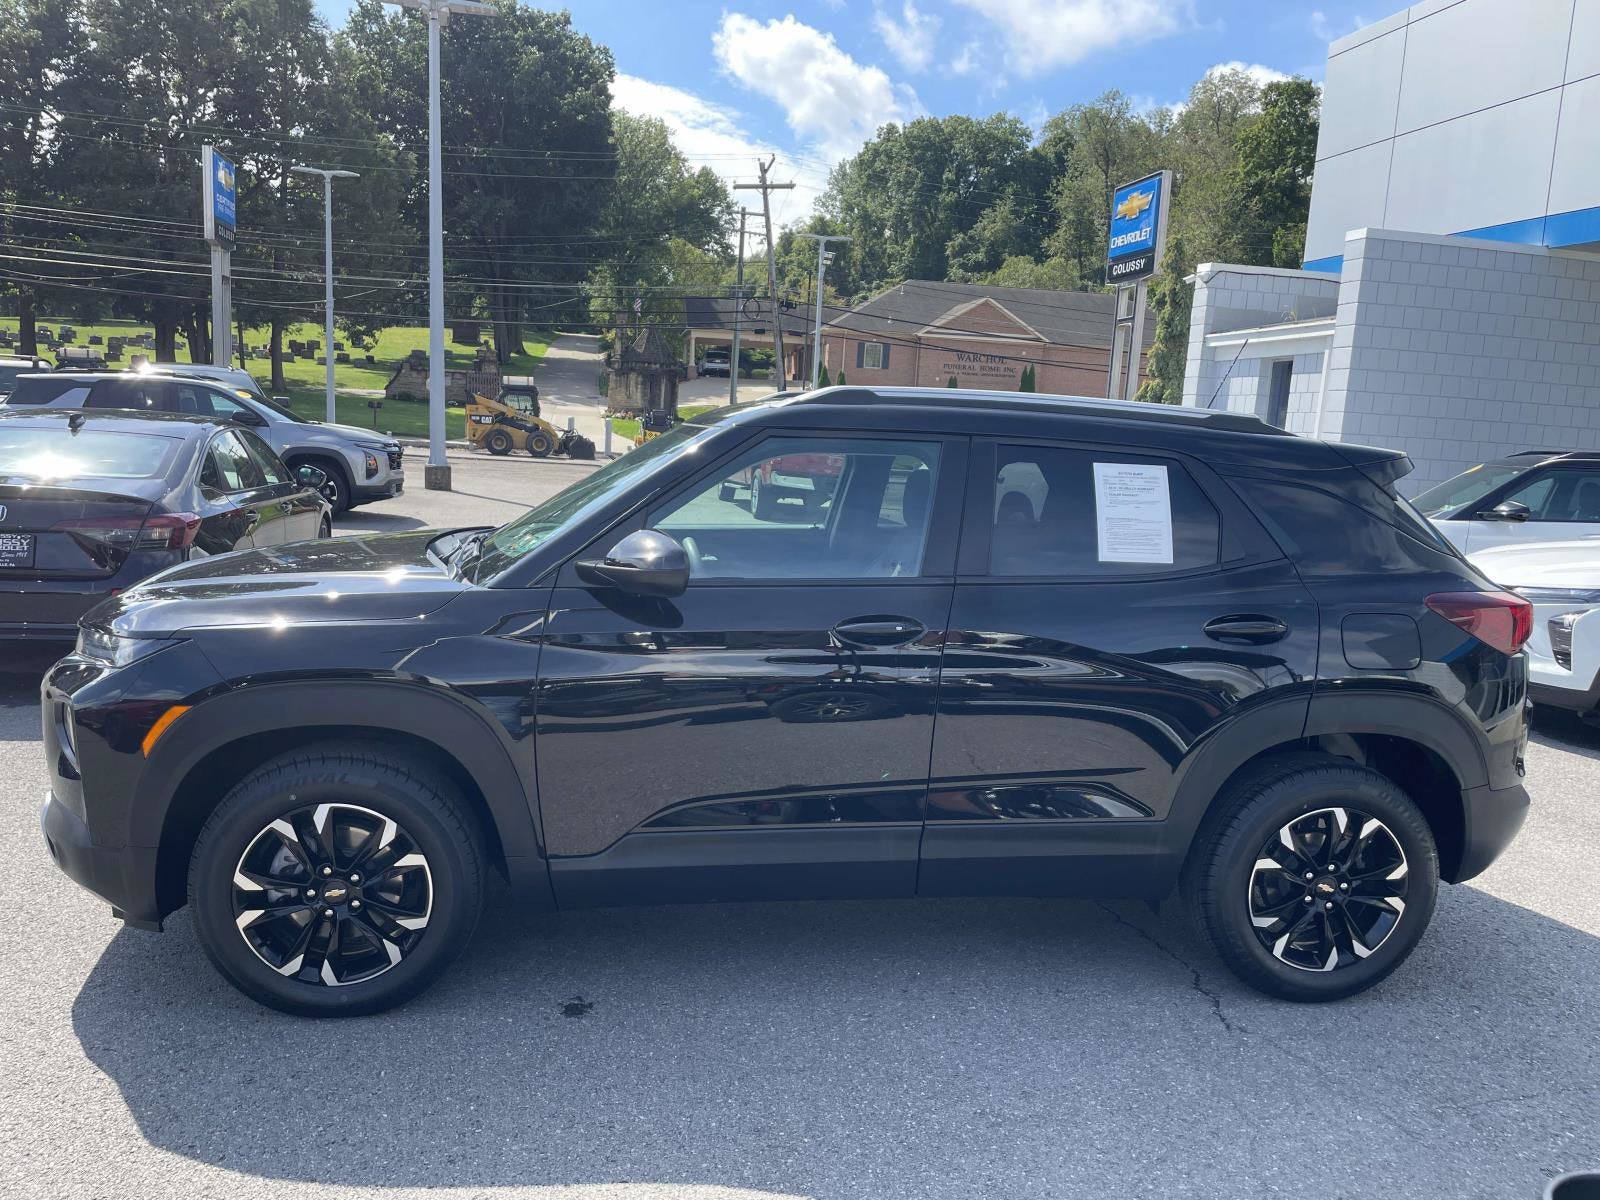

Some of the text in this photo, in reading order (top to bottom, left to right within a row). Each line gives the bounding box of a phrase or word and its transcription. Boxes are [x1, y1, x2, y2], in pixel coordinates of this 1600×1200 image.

[1110, 227, 1151, 249] CHEVROLET
[1112, 258, 1146, 276] COLUSSY
[957, 353, 1007, 365] WARCHOL
[943, 363, 1017, 374] FUNERAL HOME INC
[481, 416, 493, 424] CAT
